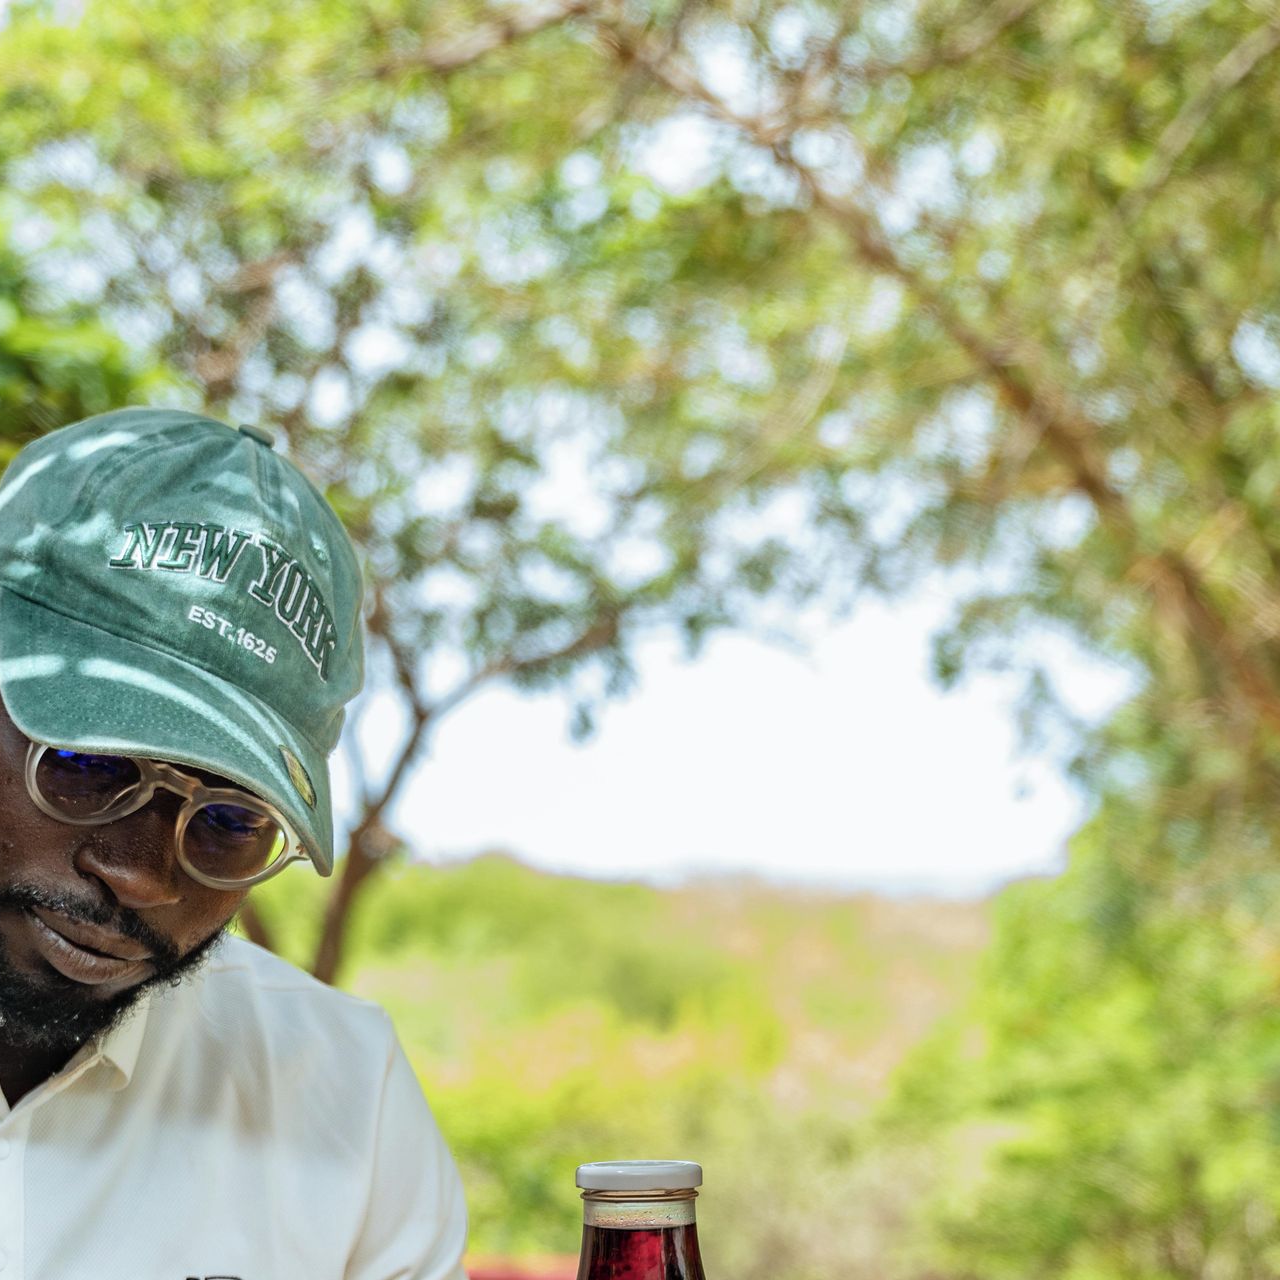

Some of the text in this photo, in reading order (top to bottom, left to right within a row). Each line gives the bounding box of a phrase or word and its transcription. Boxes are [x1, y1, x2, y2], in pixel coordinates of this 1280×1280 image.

[109, 521, 338, 684] NEW YORK
[188, 605, 278, 664] EST.1625
